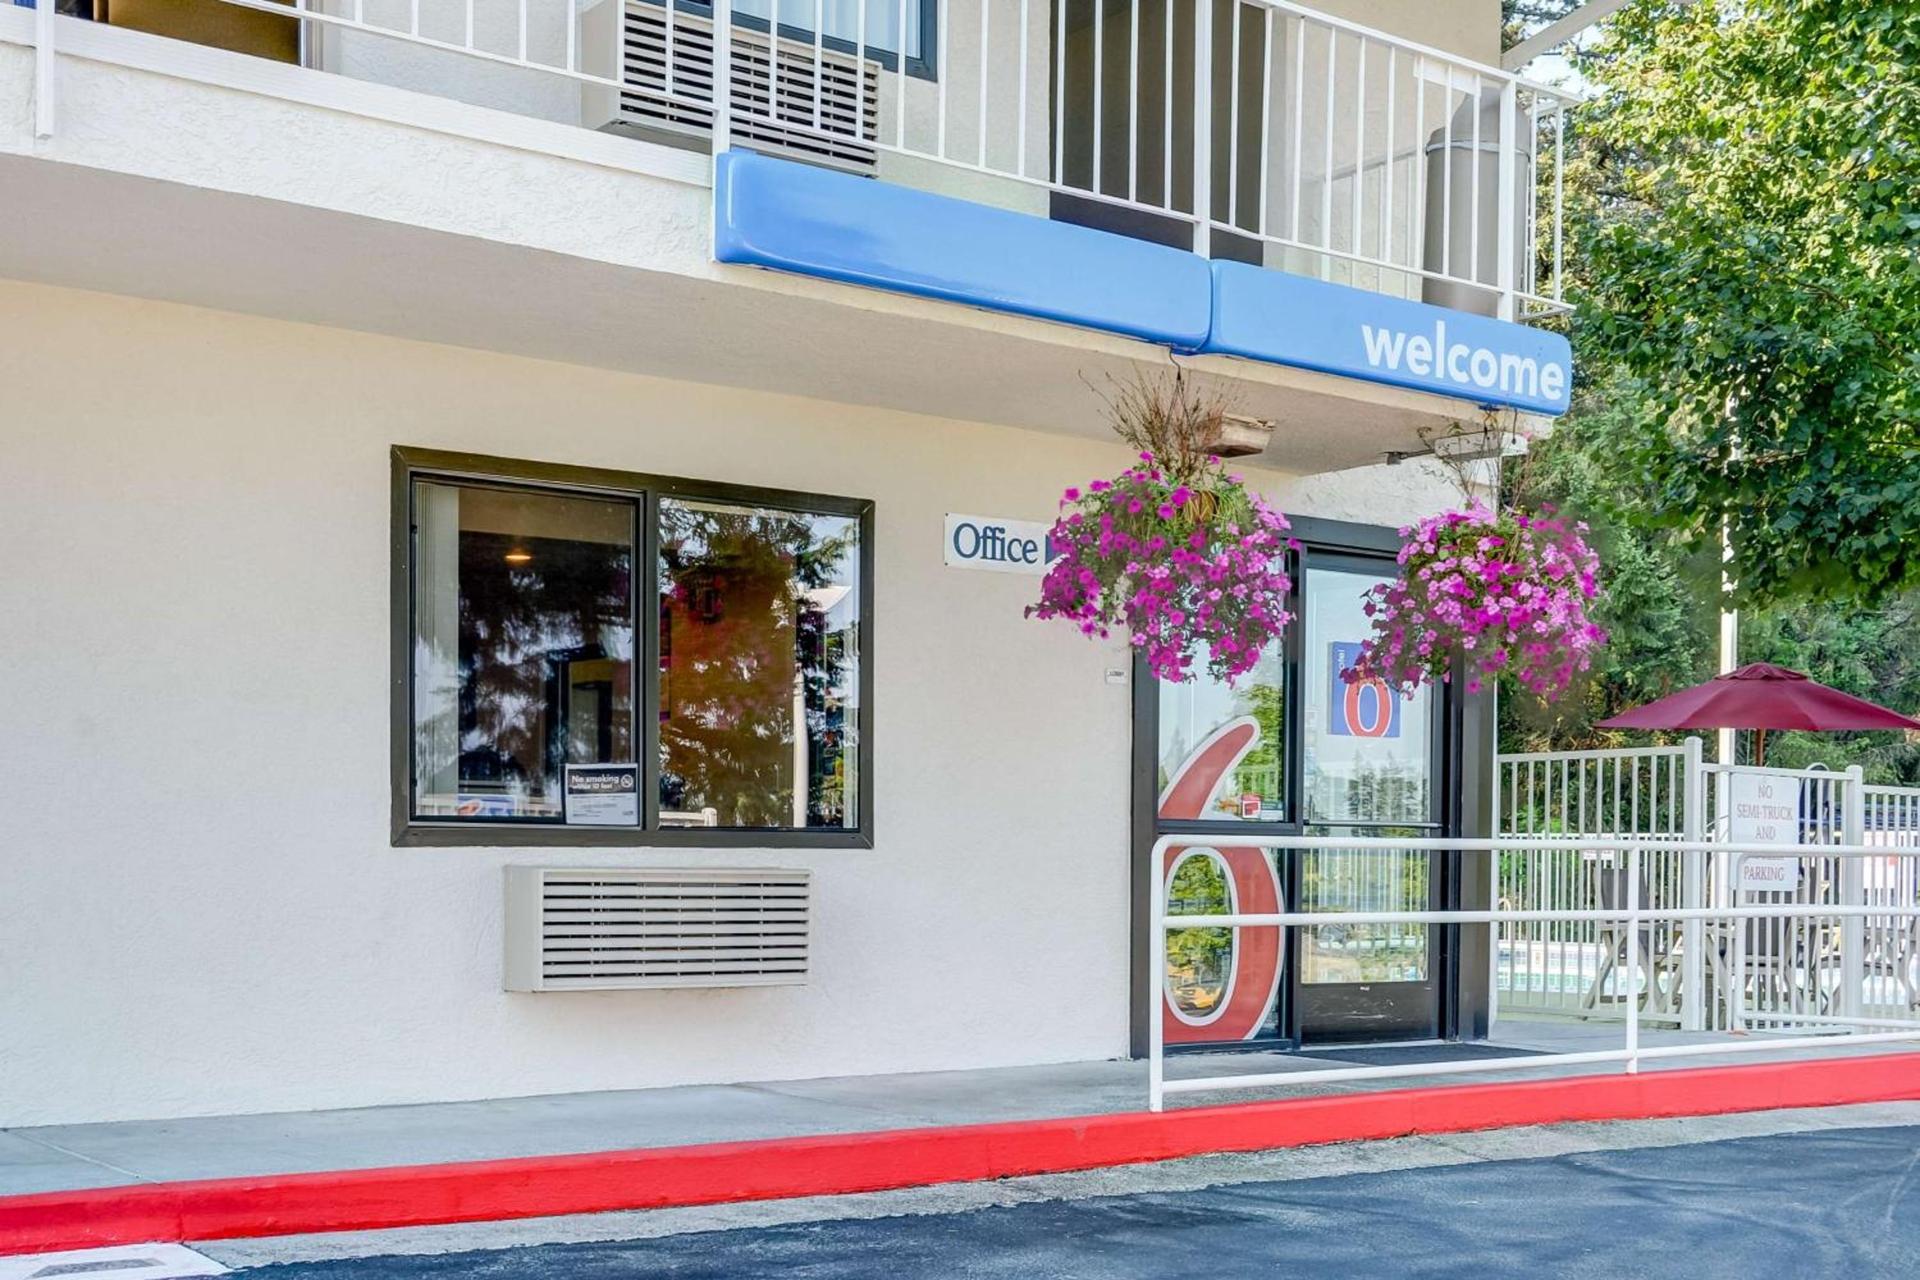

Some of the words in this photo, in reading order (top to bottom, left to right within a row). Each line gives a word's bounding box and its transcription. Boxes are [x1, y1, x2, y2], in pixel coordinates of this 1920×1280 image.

[1361, 319, 1565, 400] welcome
[953, 522, 1038, 564] Office
[586, 774, 619, 784] smoking
[1758, 784, 1773, 800] NO
[1736, 803, 1793, 821] SEMI-TRUCK
[1755, 826, 1776, 841] AND
[1743, 866, 1785, 881] PARKING
